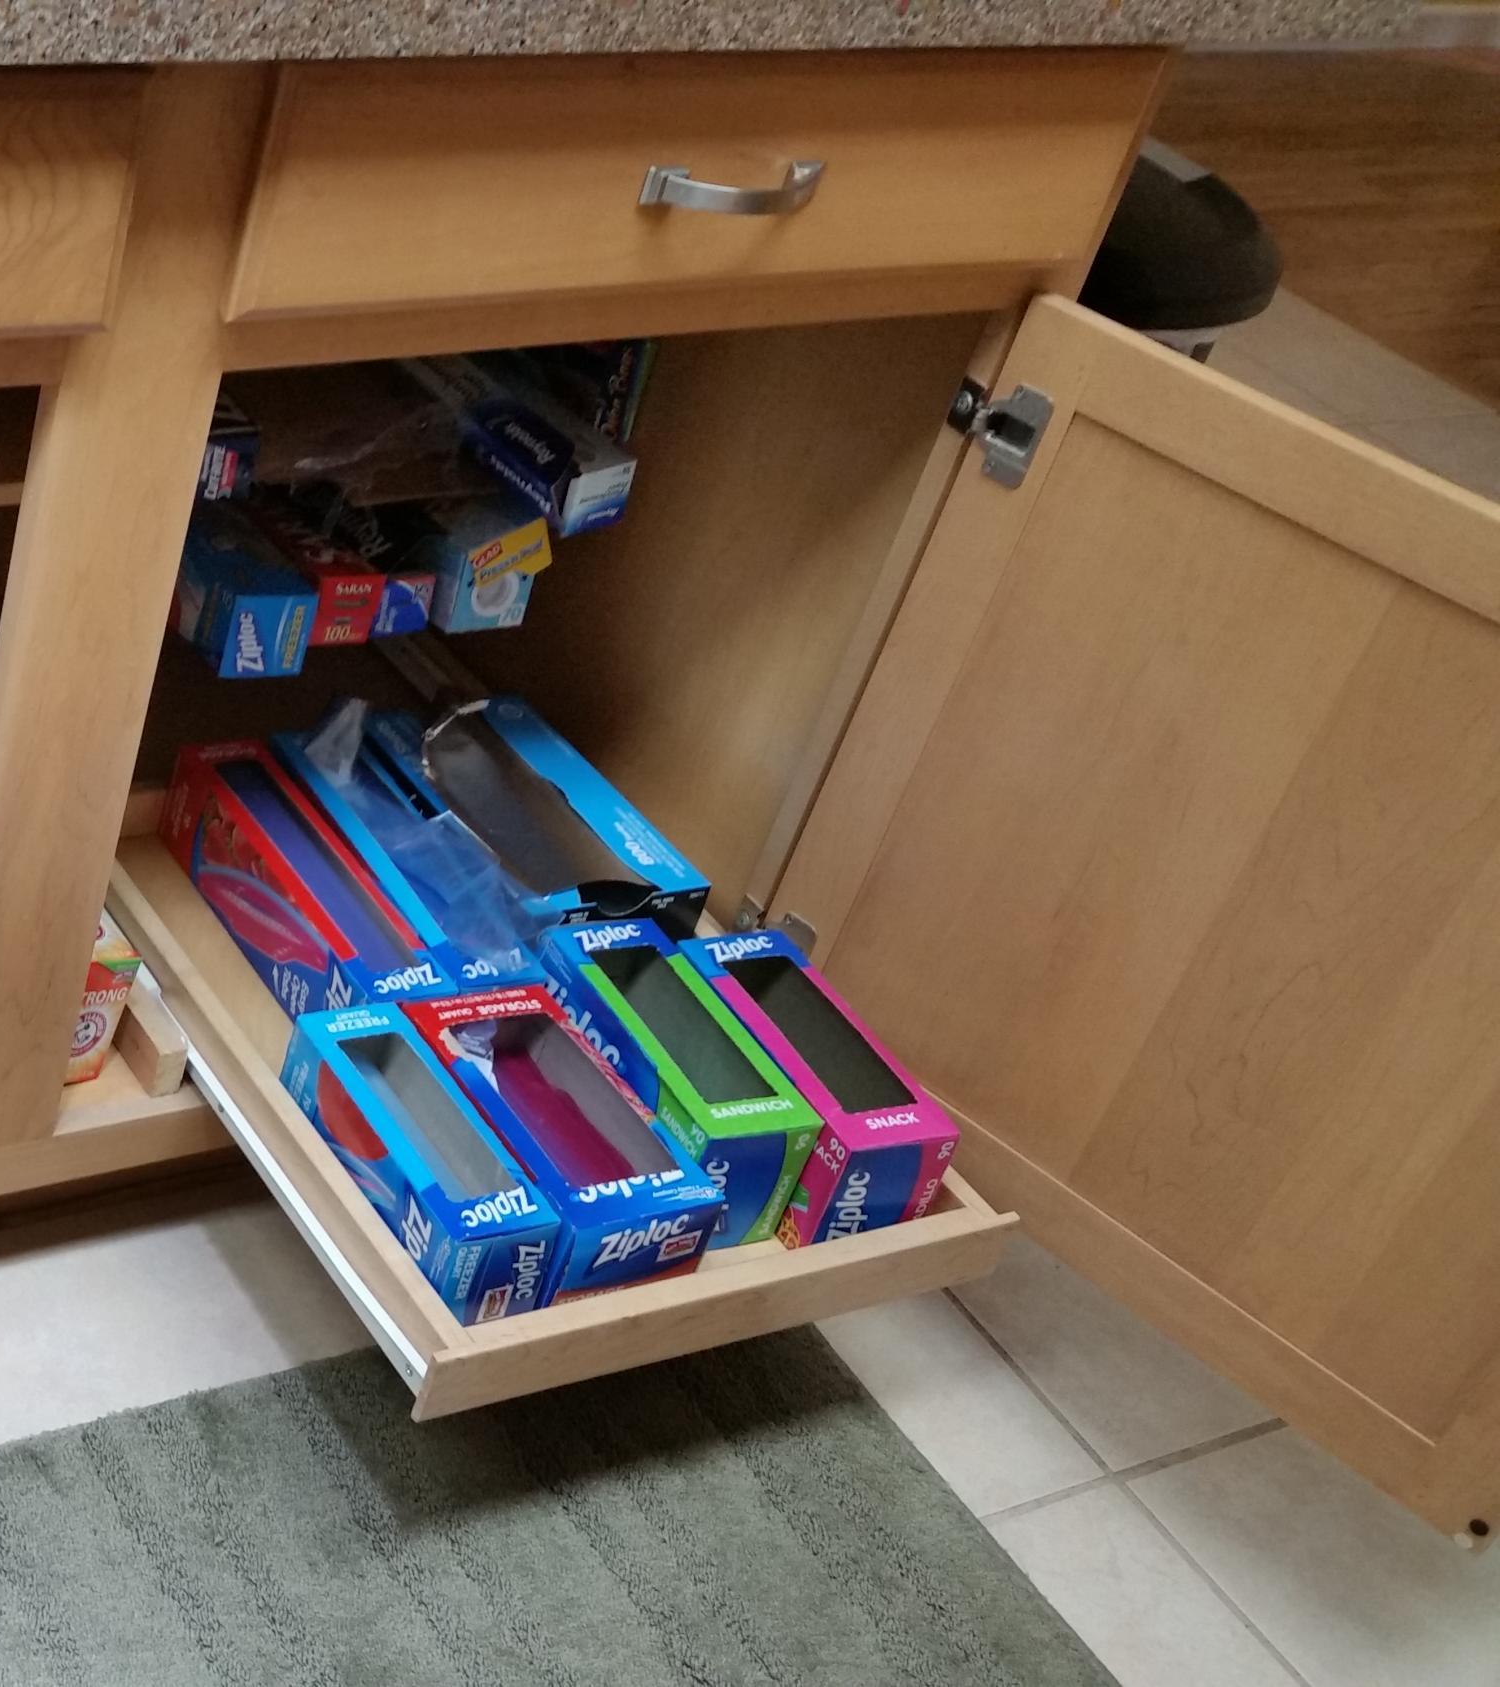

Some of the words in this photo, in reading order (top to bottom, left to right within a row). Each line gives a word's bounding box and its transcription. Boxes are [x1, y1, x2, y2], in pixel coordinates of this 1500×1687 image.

[235, 612, 265, 673] Ziploc
[324, 625, 350, 642] 100
[572, 923, 641, 953] Ziploc
[704, 936, 774, 964] Ziploc
[373, 962, 442, 995] Ziploc
[84, 985, 128, 1006] TRONG
[475, 999, 543, 1015] STORAGE
[325, 1015, 390, 1034] FREEZER
[709, 1098, 794, 1120] SANDWICH
[864, 1111, 920, 1131] SNACK
[814, 1140, 841, 1175] ACK
[829, 1137, 846, 1161] 90
[937, 1141, 955, 1161] 90
[461, 1185, 539, 1229] Ziploc
[824, 1170, 872, 1242] Ziploc
[400, 1193, 433, 1263] Zip
[591, 1213, 690, 1272] Ziploc
[454, 1245, 482, 1301] FREEZER
[511, 1239, 547, 1301] Ziploc
